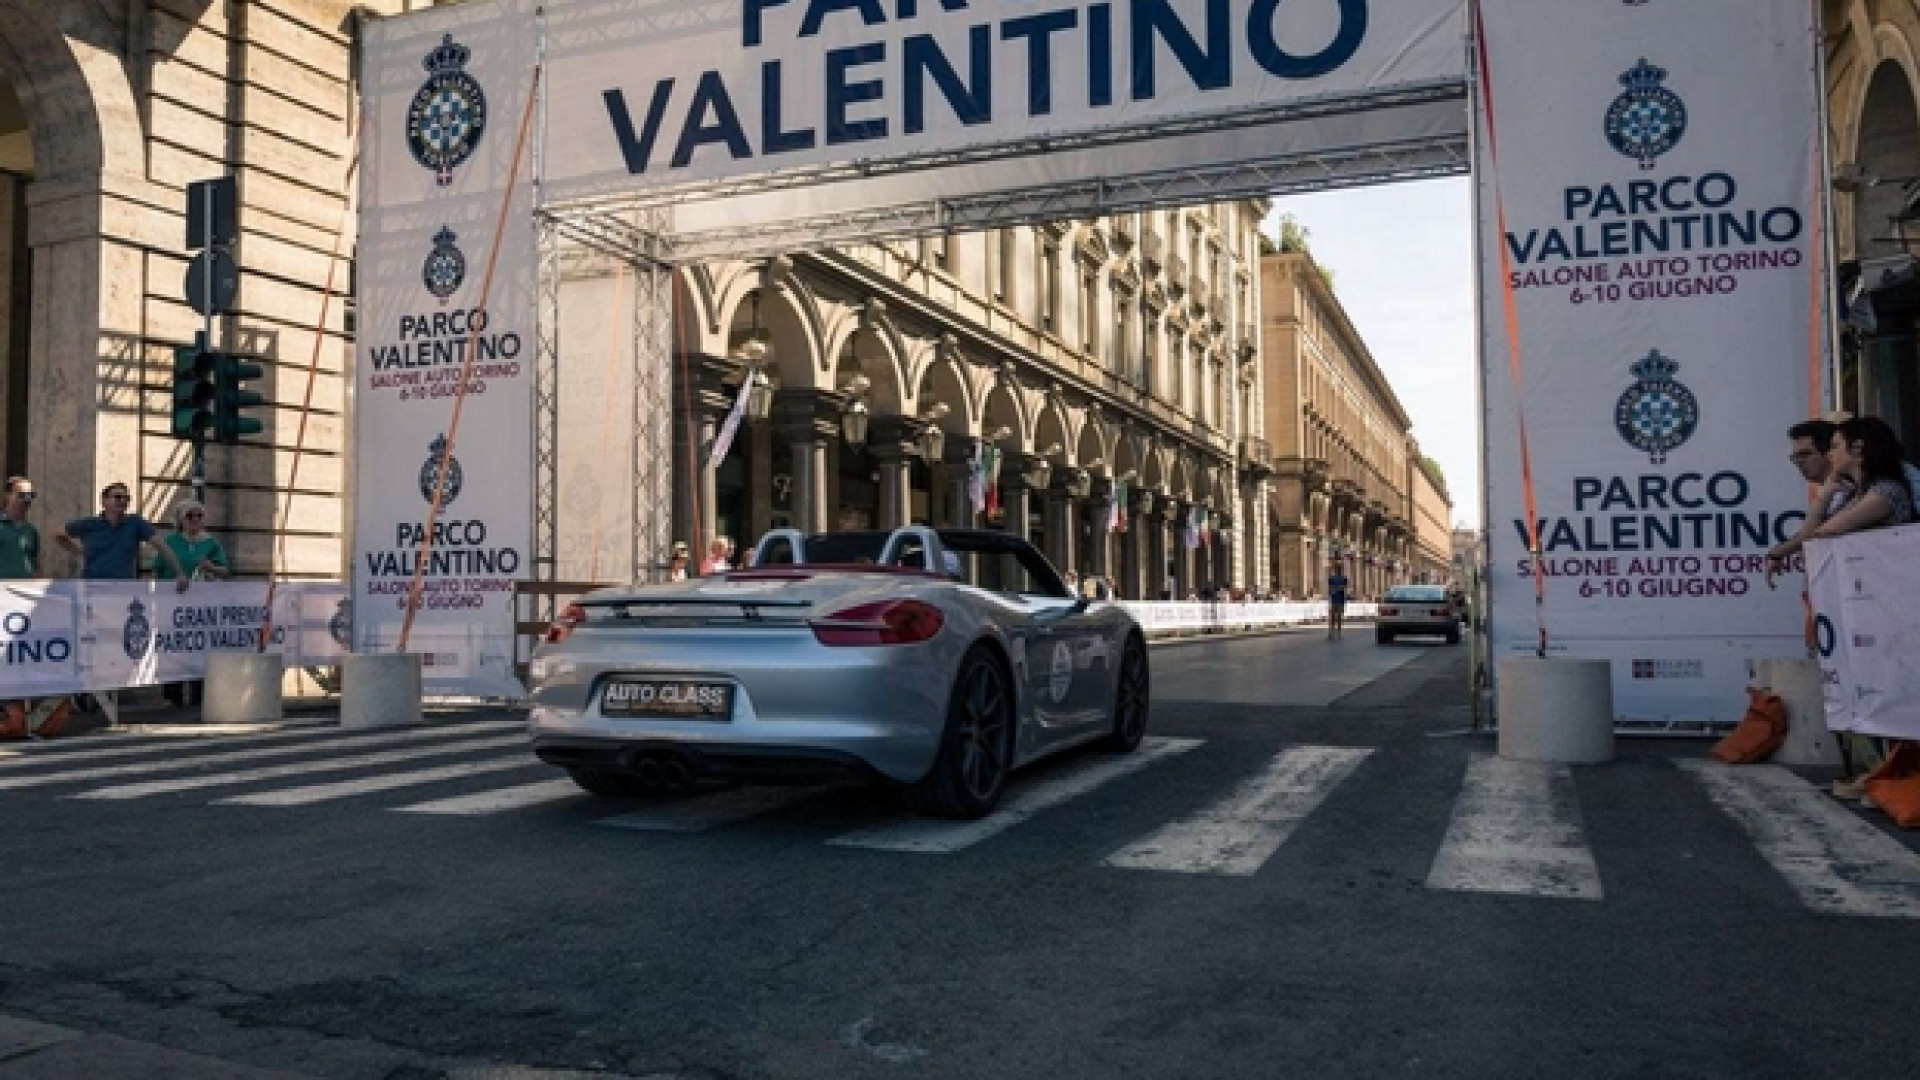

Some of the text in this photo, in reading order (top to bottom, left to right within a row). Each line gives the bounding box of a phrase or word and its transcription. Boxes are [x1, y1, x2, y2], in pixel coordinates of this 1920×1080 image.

[603, 0, 1368, 173] VALENTINO
[1564, 172, 1736, 220] PARCO
[1506, 206, 1803, 263] VALENTINO
[1510, 248, 1803, 289] SALONE AUTO TORINO
[1570, 275, 1738, 304] 6-10 GIUGNO
[400, 308, 489, 341] PARCO
[370, 332, 521, 370] VALENTNO
[1573, 470, 1750, 511] PARCO
[1626, 555, 1702, 577] AUTO
[1579, 575, 1750, 598] 6-10 GIUGNO
[173, 605, 217, 629] GRAN
[606, 683, 725, 706] AUTO CLASS
